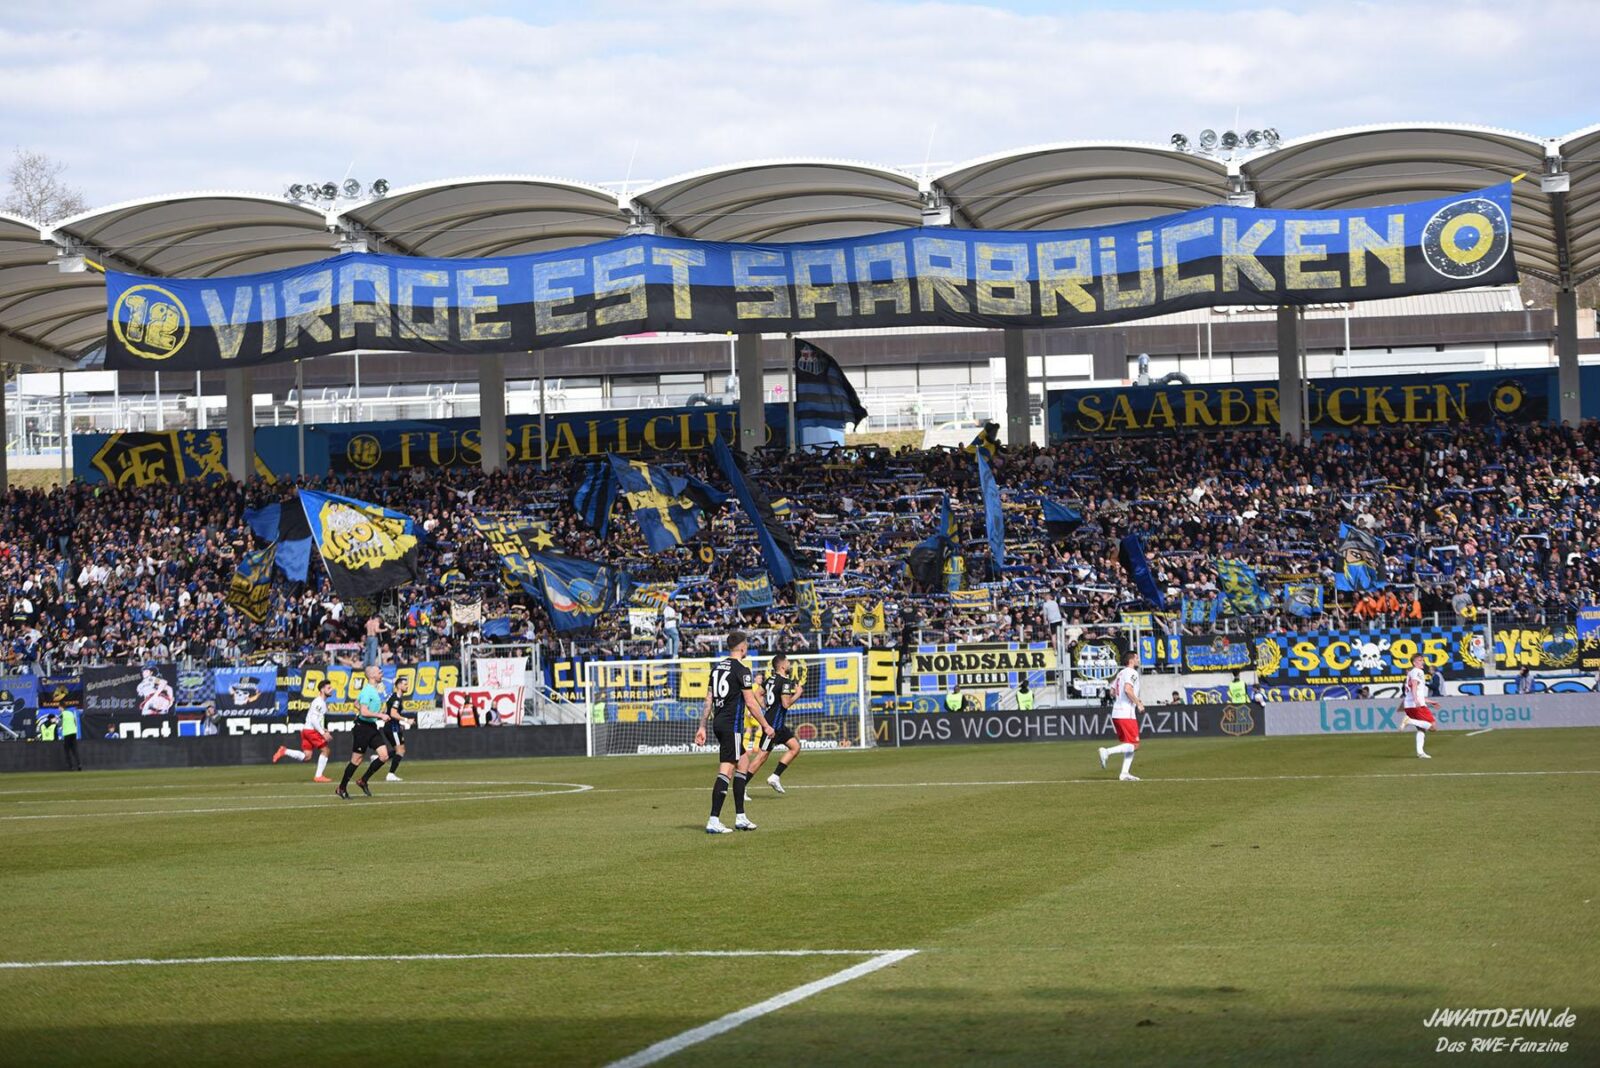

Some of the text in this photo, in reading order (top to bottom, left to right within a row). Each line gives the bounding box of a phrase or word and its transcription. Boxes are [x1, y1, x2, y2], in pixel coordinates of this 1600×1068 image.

[201, 214, 1405, 359] VIRAGE EST SAARBRÜCKEN
[126, 295, 180, 350] 12
[916, 652, 1046, 672] NORDSAAR
[1390, 638, 1449, 669] 95
[554, 661, 667, 688] CLIQUE
[712, 670, 730, 698] 16
[959, 673, 1006, 684] JUGEND
[447, 691, 515, 719] SFC
[1320, 702, 1531, 732] laux ertigbau
[901, 717, 951, 741] DAS
[961, 711, 1199, 738] WOCHENMAAZIN
